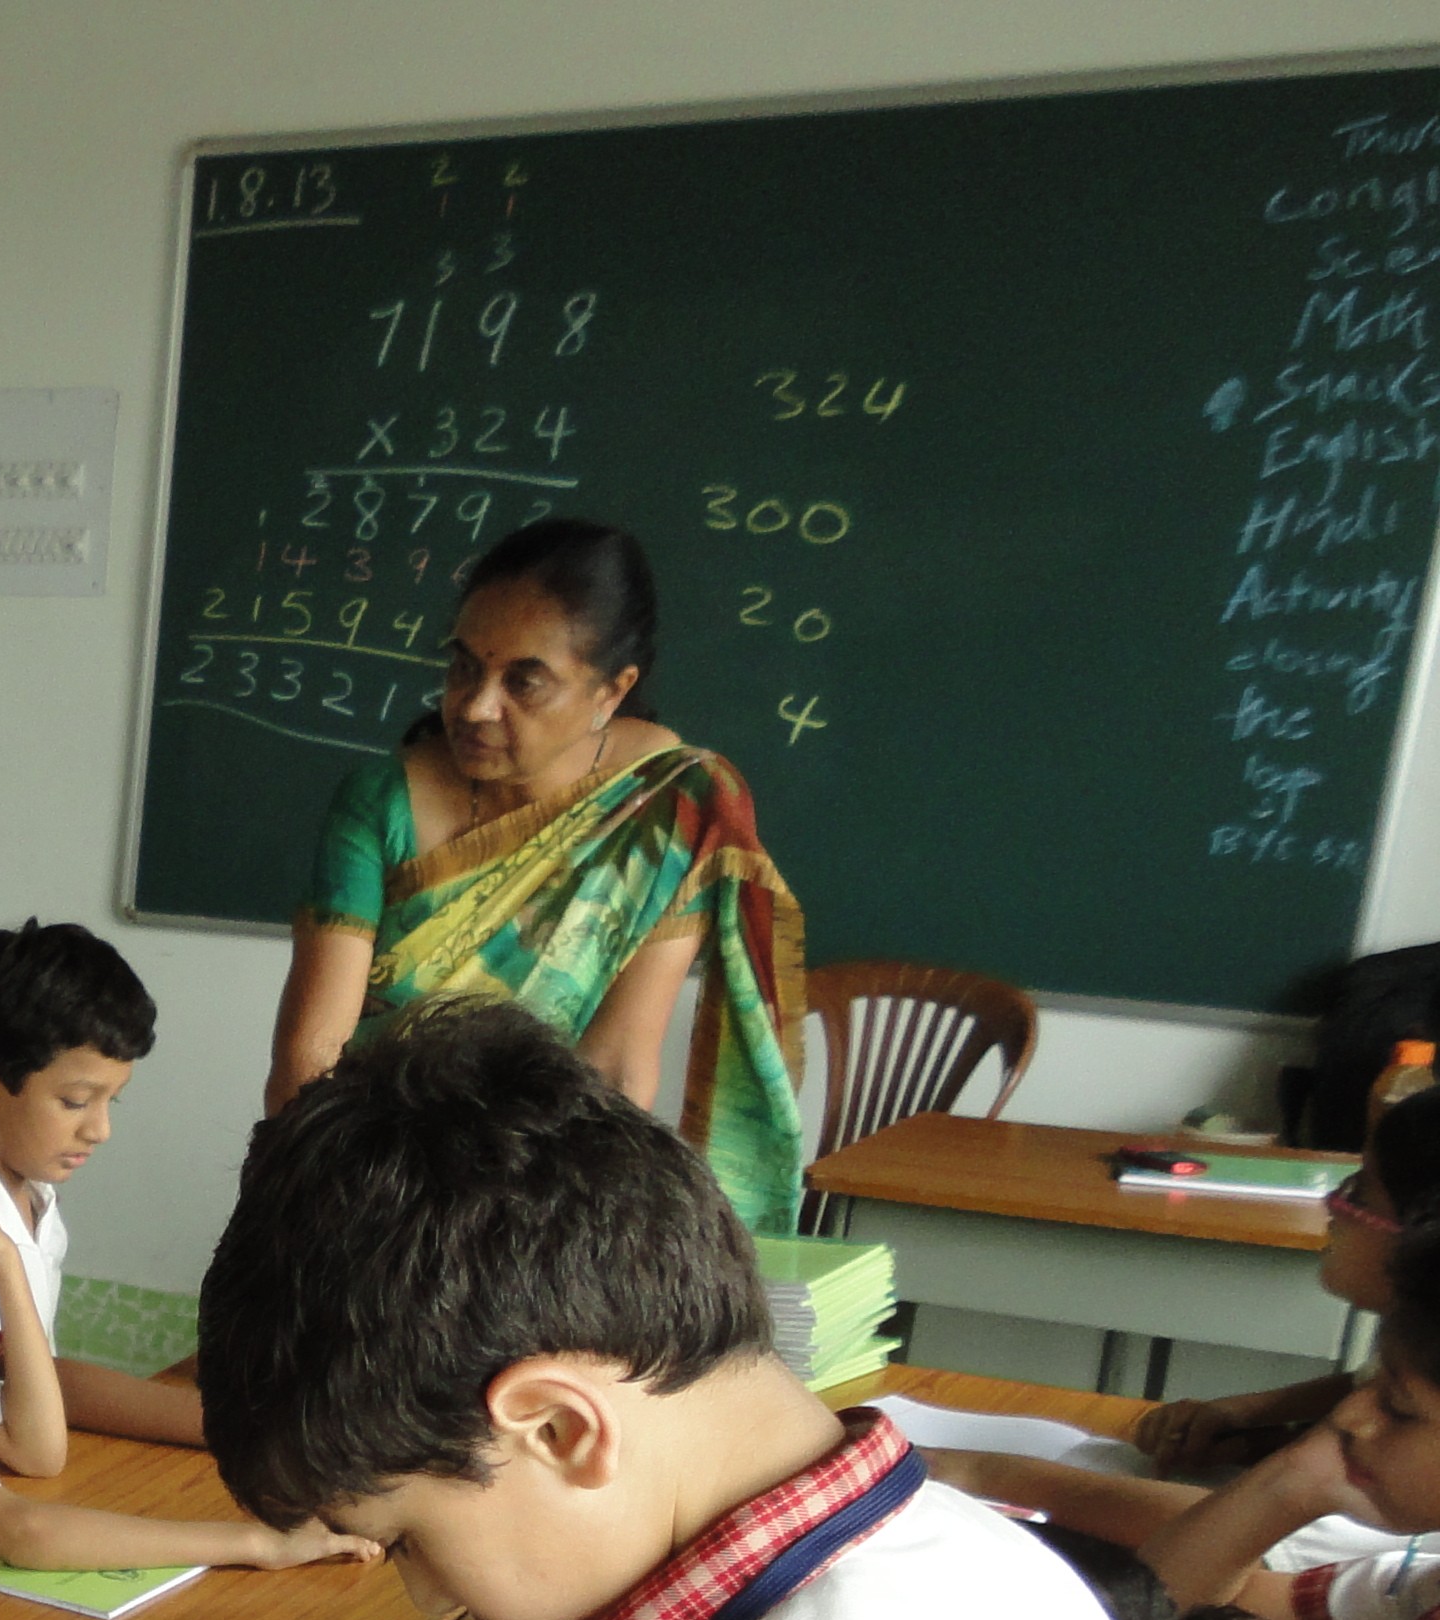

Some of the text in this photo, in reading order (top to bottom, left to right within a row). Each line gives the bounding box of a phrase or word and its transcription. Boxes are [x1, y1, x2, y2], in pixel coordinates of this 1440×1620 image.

[369, 291, 597, 373] 7198
[754, 368, 907, 424] 324
[428, 404, 577, 464] 324
[700, 483, 850, 545] 300
[203, 588, 454, 650] 21594
[739, 586, 832, 643] 20
[777, 694, 828, 747] 4
